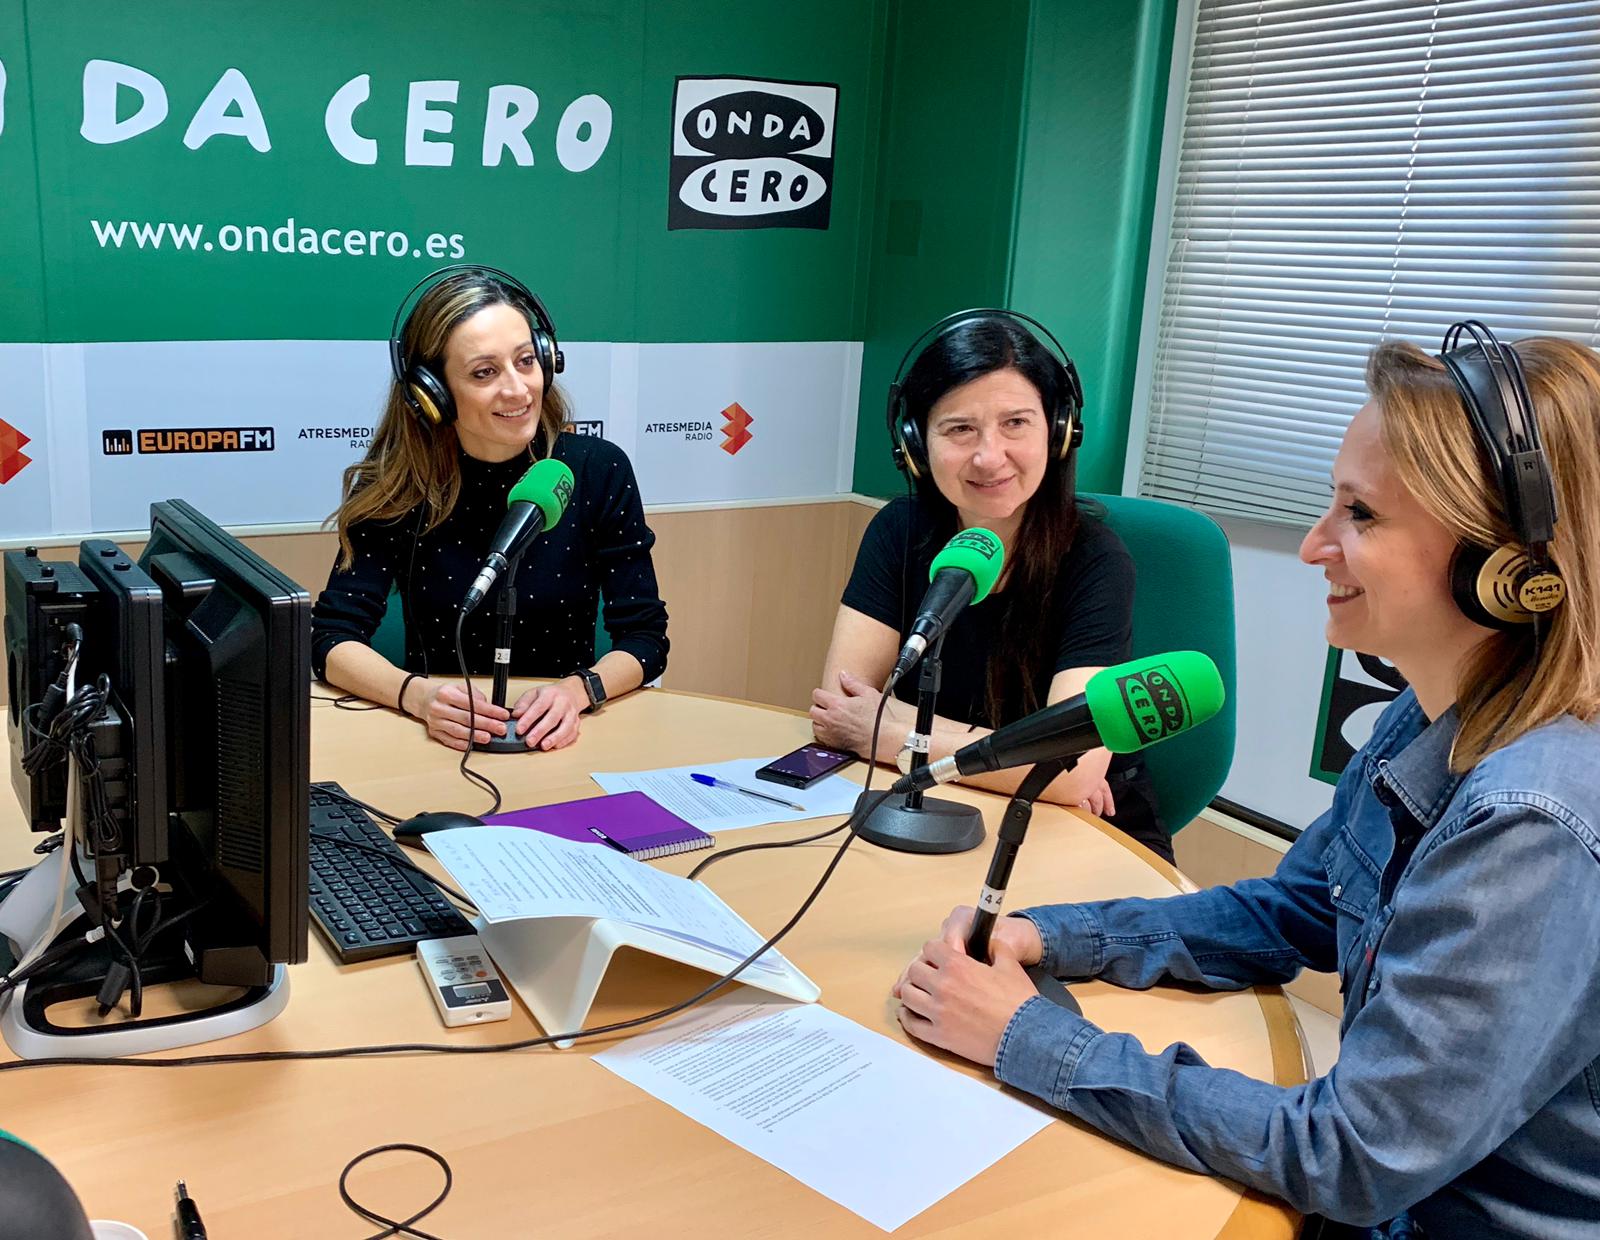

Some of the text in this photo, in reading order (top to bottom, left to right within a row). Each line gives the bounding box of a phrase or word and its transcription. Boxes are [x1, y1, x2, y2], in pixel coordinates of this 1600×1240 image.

[0, 58, 613, 173] DA CERO
[696, 108, 812, 141] ONDA
[701, 168, 809, 203] CERO
[90, 217, 466, 259] www.ondacero.es
[298, 427, 375, 439] ATRESMEDI
[645, 421, 713, 433] ATRESMEDIA
[685, 432, 713, 441] RADIO
[1525, 583, 1561, 596] K141
[1130, 684, 1159, 736] CERO
[1150, 674, 1179, 729] ONDA
